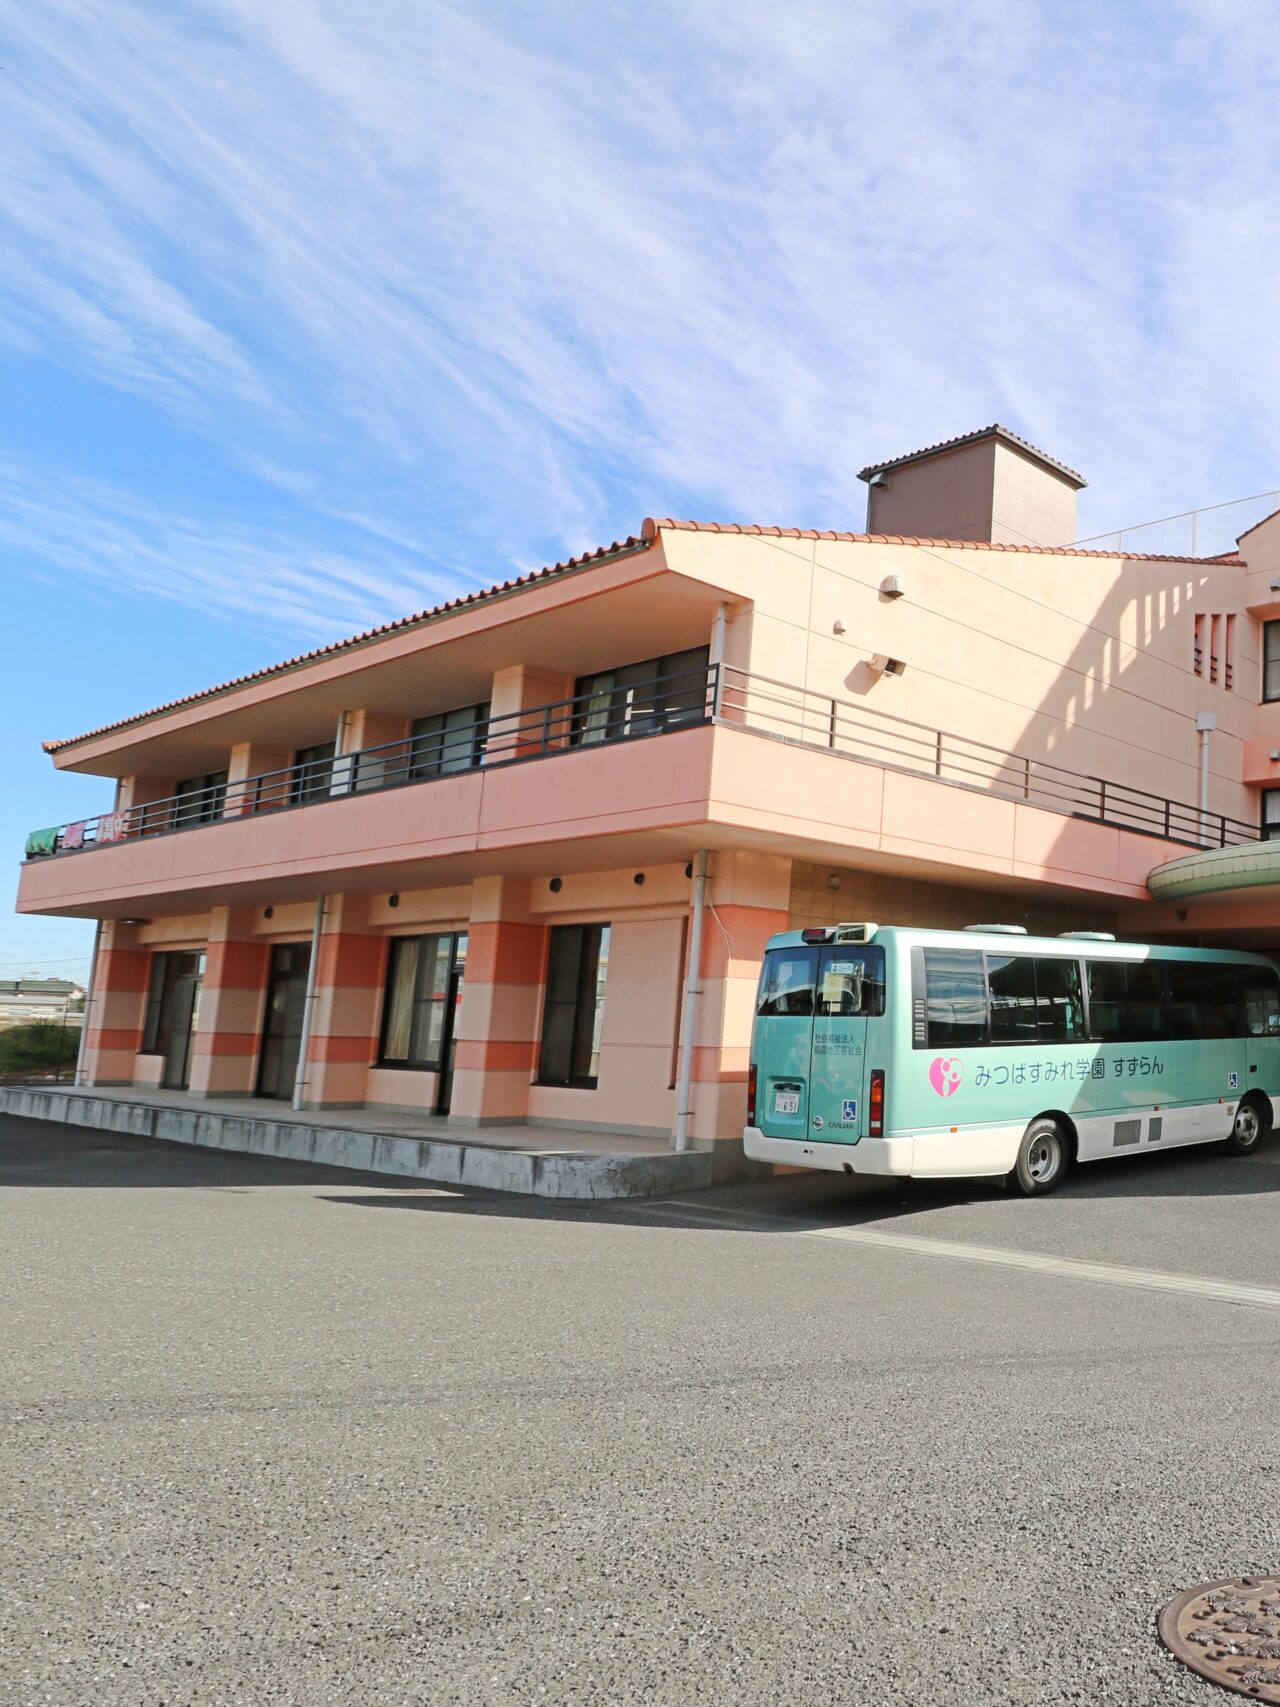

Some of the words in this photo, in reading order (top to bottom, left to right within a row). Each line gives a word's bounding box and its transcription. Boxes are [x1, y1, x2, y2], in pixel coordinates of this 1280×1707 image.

[975, 1058, 1105, 1087] みつばすみれ学園
[1112, 1056, 1164, 1078] すずらん
